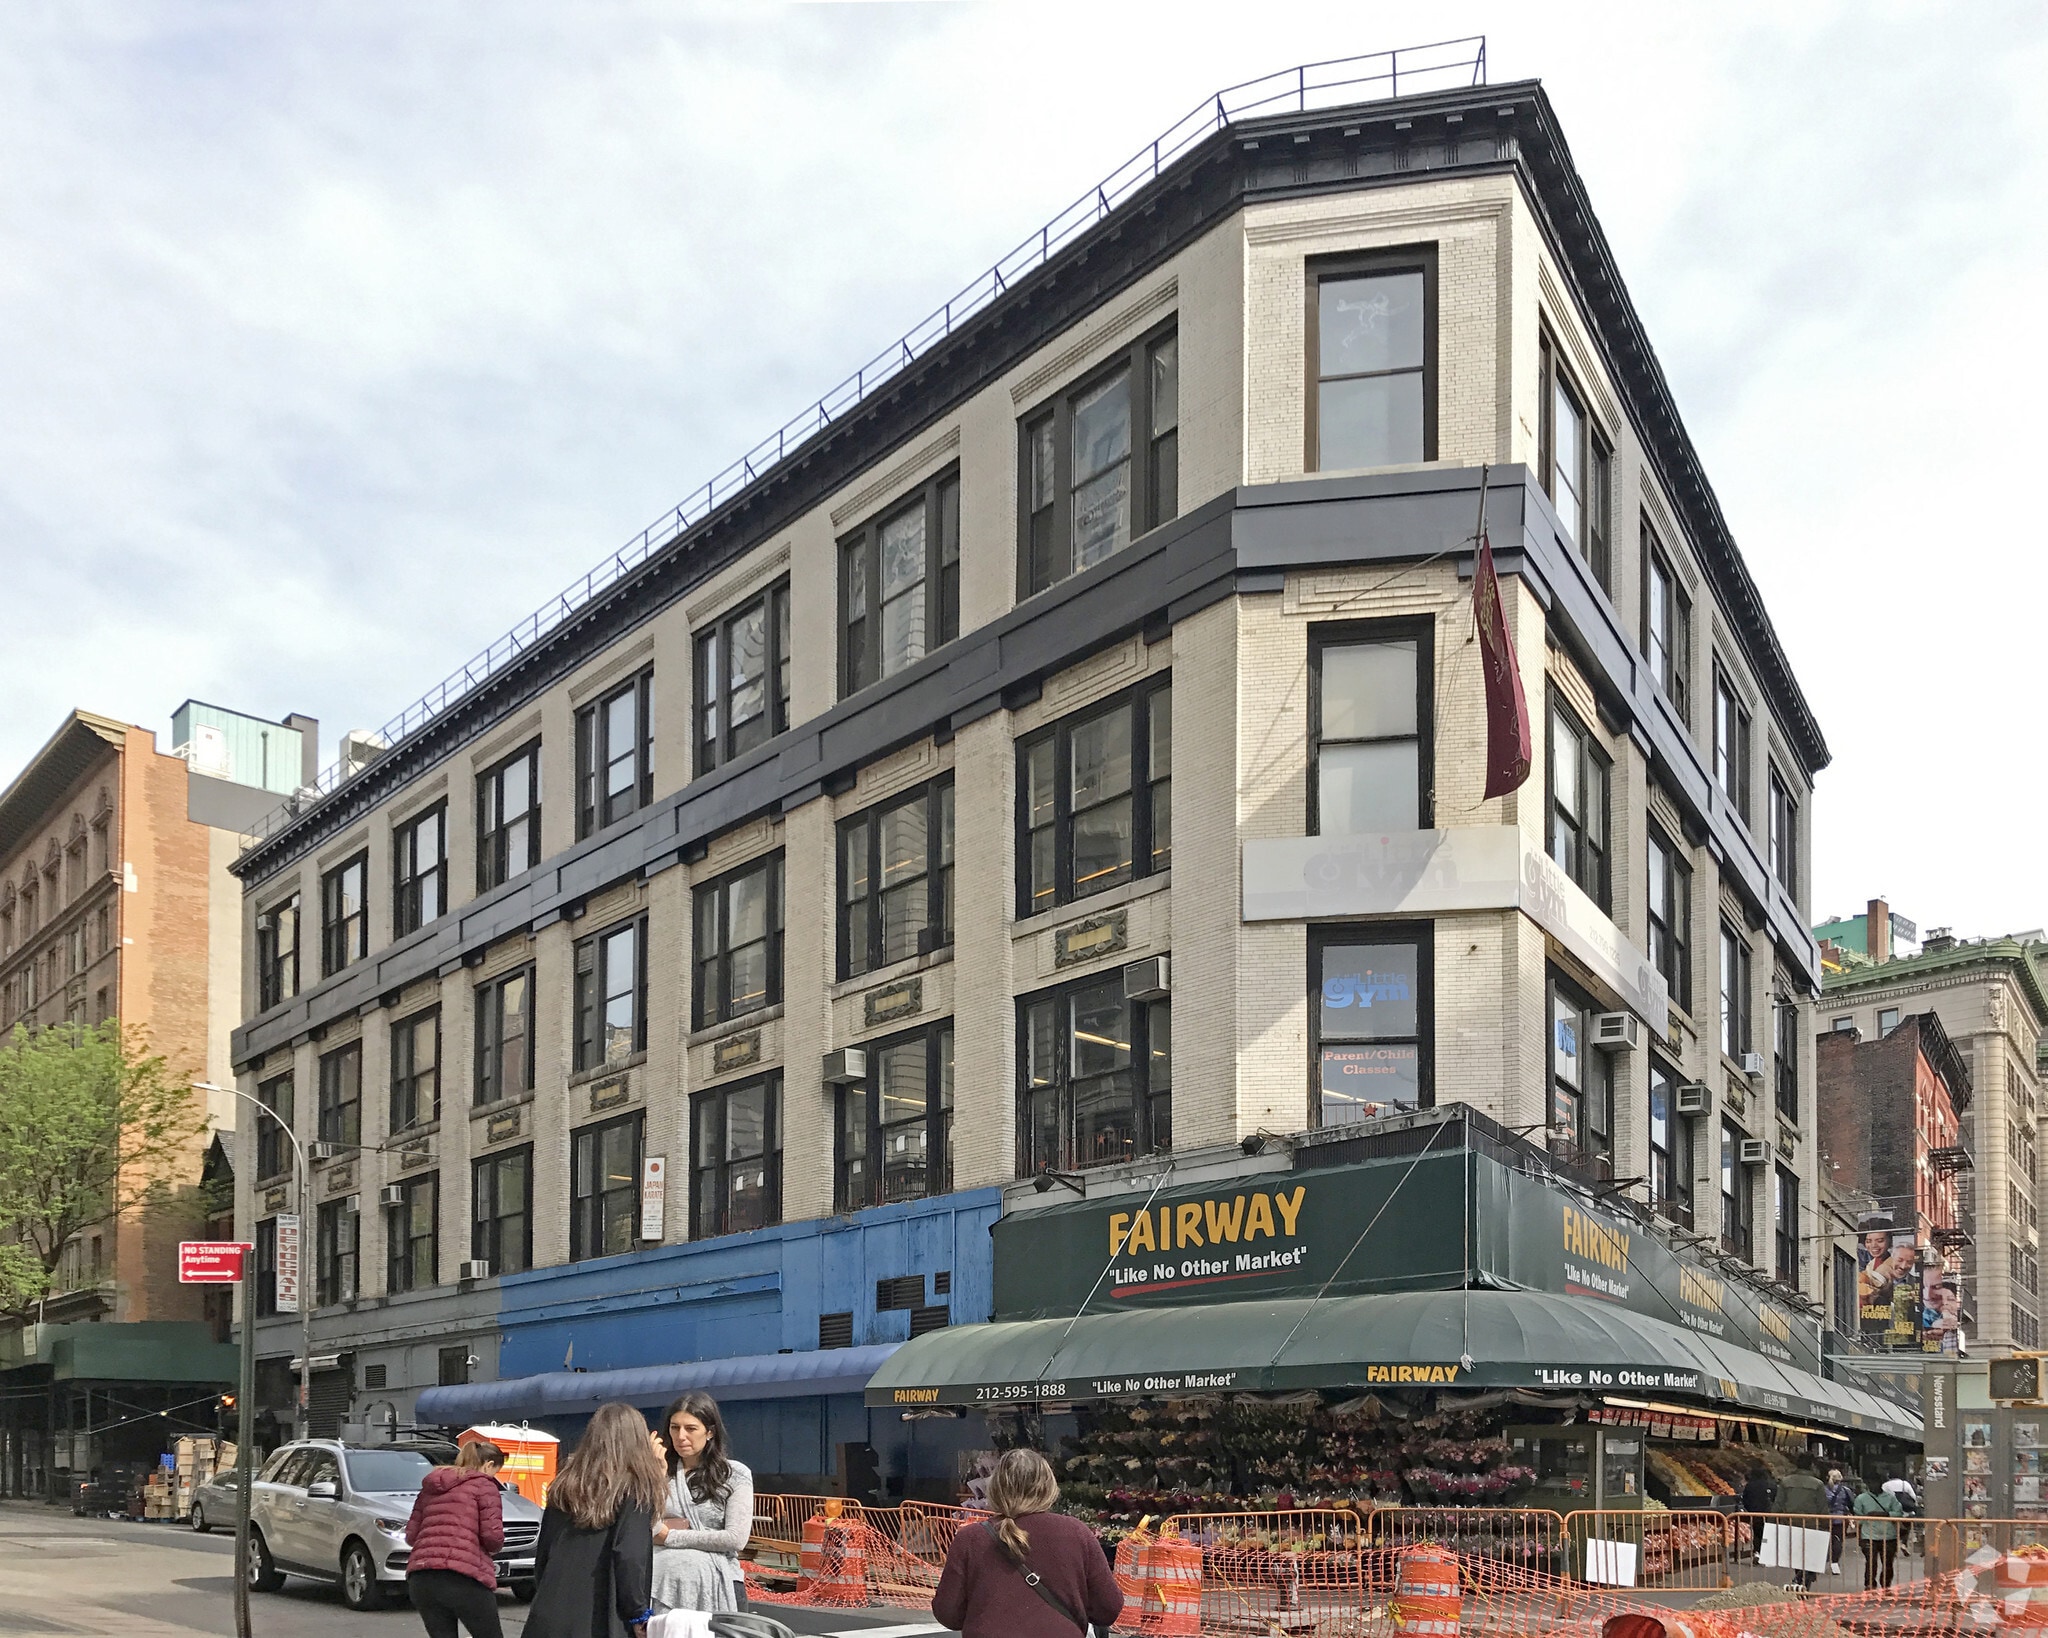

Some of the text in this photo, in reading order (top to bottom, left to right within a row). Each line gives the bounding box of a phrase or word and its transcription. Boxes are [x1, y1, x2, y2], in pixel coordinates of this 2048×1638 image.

[1323, 977, 1409, 1008] gym
[1324, 1050, 1415, 1061] Parent/Child
[1342, 1064, 1396, 1075] Classes
[1109, 1186, 1307, 1257] FAIRWAY
[184, 1246, 241, 1255] NO STANDING
[1563, 1205, 1630, 1275] FAIRWAY
[184, 1256, 221, 1264] Anytime
[279, 1227, 298, 1302] DEMOCRATS
[1109, 1246, 1307, 1285] "Like No Other Market"
[1581, 1268, 1591, 1287] No
[1591, 1272, 1608, 1293] Other
[1680, 1263, 1724, 1316] FAIRWAY
[1092, 1373, 1236, 1394] "Like No Other Market"
[1367, 1365, 1459, 1383] FAIRWAY
[1534, 1369, 1583, 1385] "Like
[1589, 1370, 1613, 1385] No
[1618, 1370, 1660, 1386] Other
[894, 1384, 1066, 1403] FAIRWAY 212-595-1888
[1933, 1375, 1946, 1429] Newsstand
